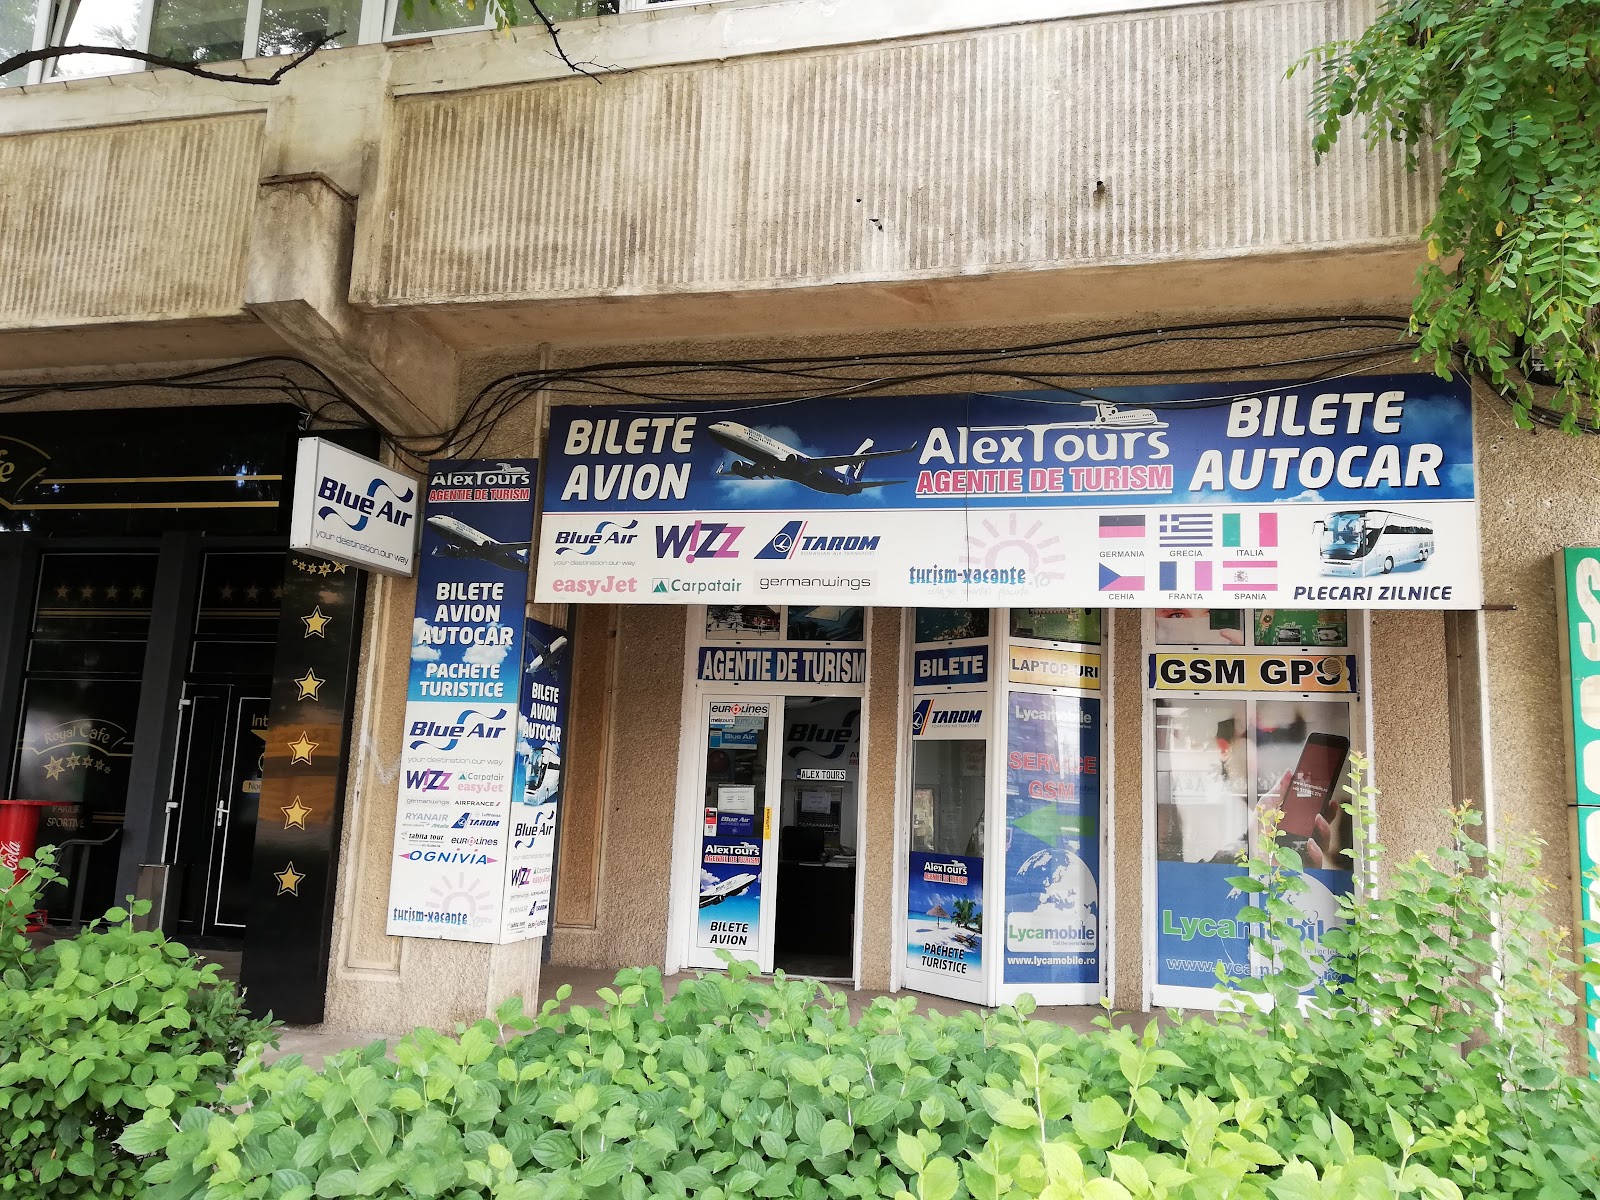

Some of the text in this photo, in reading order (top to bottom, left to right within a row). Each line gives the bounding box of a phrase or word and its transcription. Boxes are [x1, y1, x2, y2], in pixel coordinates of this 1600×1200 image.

[1226, 391, 1404, 437] BILETE
[564, 417, 697, 455] BILETE
[1189, 444, 1443, 490] AUTOCAR
[561, 463, 692, 501] AVION
[916, 465, 1173, 494] AGENTIE DE TURISM
[318, 476, 412, 528] Blue Air
[429, 488, 530, 502] AGENTIE DE TURISM
[555, 531, 638, 545] Blue Air
[802, 535, 881, 551] TAROM
[315, 529, 335, 543] your
[394, 554, 409, 566] way
[1236, 549, 1264, 557] ITALIA
[436, 582, 504, 601] BILETE
[552, 575, 638, 597] easyJet
[671, 578, 742, 593] Carpatair
[760, 576, 871, 591] germanwings
[1108, 593, 1135, 601] CEHIA
[1168, 593, 1204, 601] FRANTA
[1234, 593, 1267, 601] SPANIA
[1294, 586, 1453, 601] PLECARI ZILNICE
[434, 604, 501, 623] AVION
[418, 626, 514, 645] AUTOCAR
[426, 663, 501, 679] PACHETE
[702, 650, 867, 683] AGENTIE DE TURISM
[919, 655, 984, 677] BILETE
[1011, 658, 1099, 678] LAPTOP-URI
[1160, 659, 1342, 685] GSM GPS
[420, 681, 504, 697] TURISTICE
[531, 682, 560, 704] BILETE
[530, 702, 557, 723] AVION
[931, 710, 983, 723] TAROM
[44, 724, 110, 745] Royal Cafe
[409, 721, 507, 738] Blue Air
[523, 722, 562, 743] AUTOCAR
[786, 723, 852, 743] Blue
[408, 757, 425, 766] your
[487, 759, 504, 767] way
[1009, 751, 1097, 774] SERVICE
[467, 772, 504, 782] Carpatair
[801, 771, 845, 780] ALEX TOURS
[457, 782, 504, 794] easyJet
[1028, 780, 1075, 800] GSM
[405, 812, 449, 821] RYANAIR
[469, 819, 500, 827] TAROM
[515, 823, 554, 836] Blue Air
[704, 854, 728, 863] AGENTIE
[738, 857, 760, 865] TURISM
[710, 922, 749, 933] BILETE
[1009, 925, 1095, 942] Lycamobile
[710, 935, 747, 945] AVION
[924, 943, 965, 960] PACHETE
[922, 956, 967, 974] TURISTICE
[1007, 956, 1096, 965] www.lycamobile.ro
